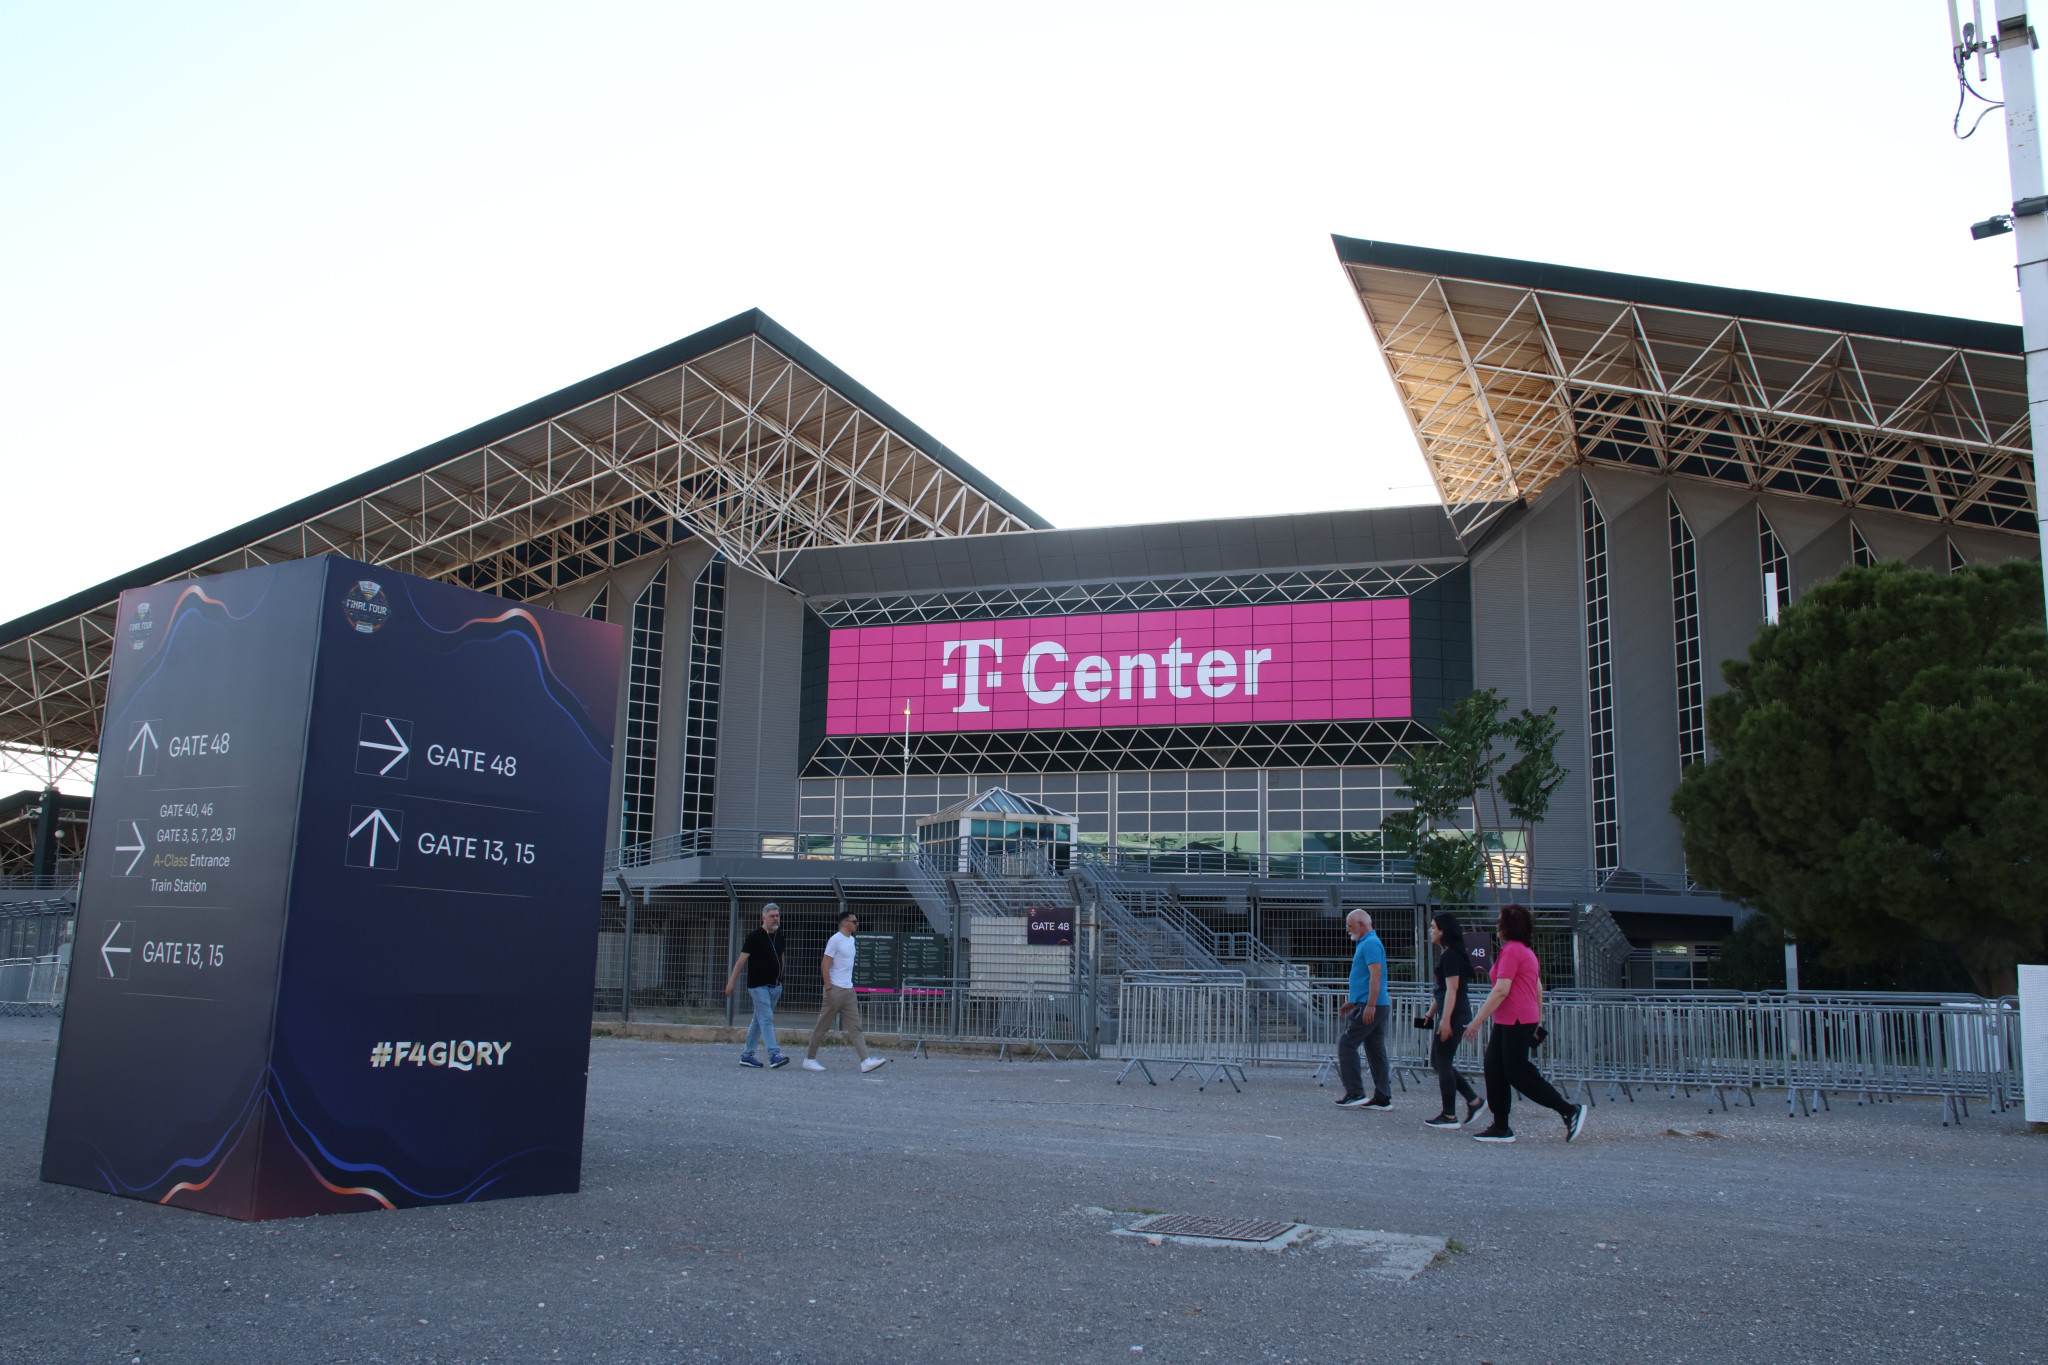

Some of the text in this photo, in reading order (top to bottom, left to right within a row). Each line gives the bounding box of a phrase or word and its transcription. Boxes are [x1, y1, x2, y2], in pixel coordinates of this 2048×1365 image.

[942, 636, 1272, 713] T Center
[169, 733, 230, 757] GATE 48
[427, 744, 517, 777] GATE 48
[160, 803, 213, 818] GATE 40, 46
[157, 828, 236, 843] GATE 3, 5, 7, 29, 31
[418, 832, 535, 865] GATE 13, 15
[153, 854, 230, 867] A-Class Entrance
[151, 879, 207, 892] Train Station
[1032, 922, 1069, 930] GATE 48
[143, 941, 224, 969] GATE 13, 15
[1472, 948, 1485, 957] 48
[370, 1040, 512, 1071] #F4GLORY
